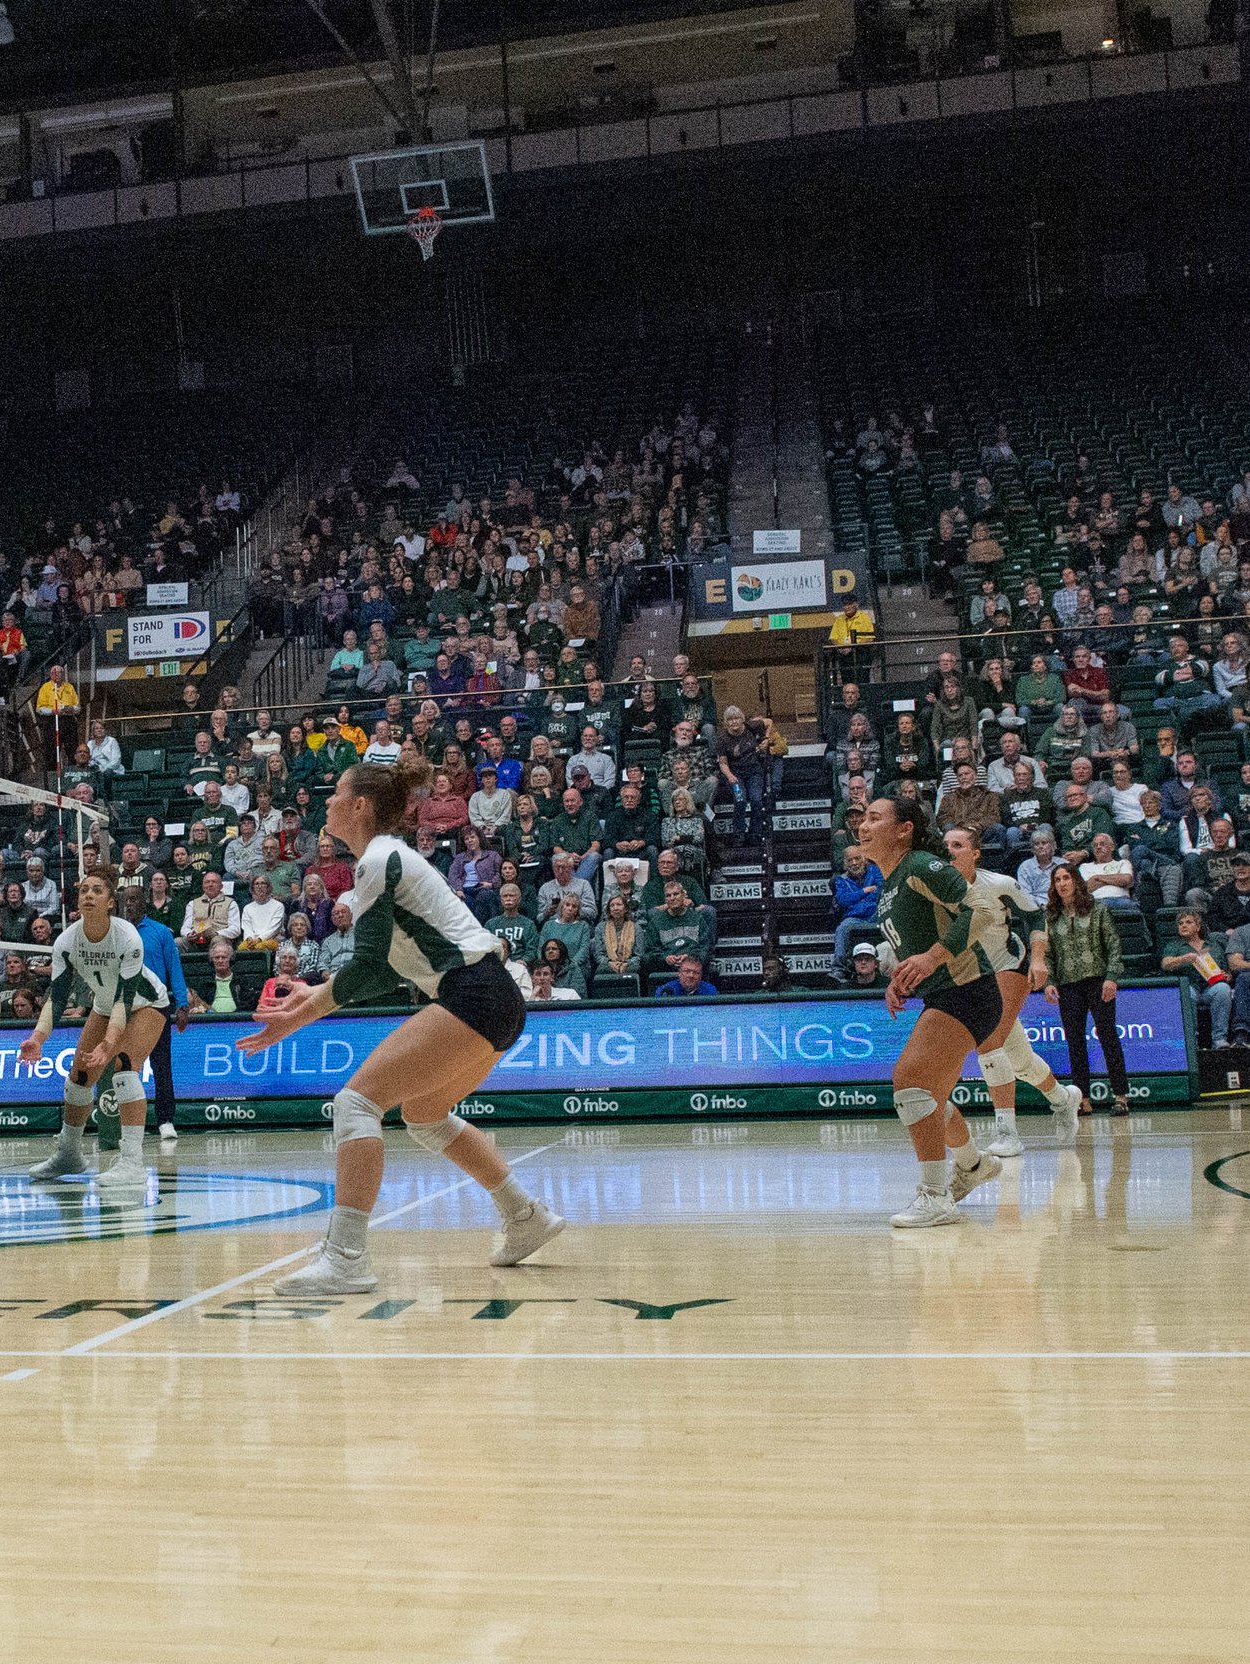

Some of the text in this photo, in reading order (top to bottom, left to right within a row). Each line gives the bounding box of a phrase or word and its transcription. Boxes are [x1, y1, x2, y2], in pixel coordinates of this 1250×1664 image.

[766, 574, 822, 592] KRAZY KARL'S
[832, 569, 856, 594] D
[705, 578, 727, 604] E
[654, 608, 662, 616] 20
[132, 620, 163, 632] STAND
[105, 628, 124, 651] F
[133, 635, 152, 645] FOR
[162, 662, 178, 675] EXIT
[790, 818, 822, 828] RAMS
[726, 888, 760, 898] RAMS
[794, 884, 827, 894] RAMS
[79, 950, 116, 960] COLORADO
[84, 959, 108, 967] STATE
[726, 962, 761, 973] RAMS
[796, 960, 832, 970] RAMS
[93, 970, 104, 987] 1
[494, 1030, 636, 1068] ZING
[653, 1022, 874, 1064] THINGS
[202, 1039, 354, 1077] BUILD
[710, 1094, 747, 1110] fnbo
[839, 1090, 877, 1106] fnbo
[974, 1087, 993, 1102] fn
[223, 1105, 256, 1120] fnbo
[459, 1099, 495, 1116] fnbo
[582, 1097, 619, 1113] fnbo
